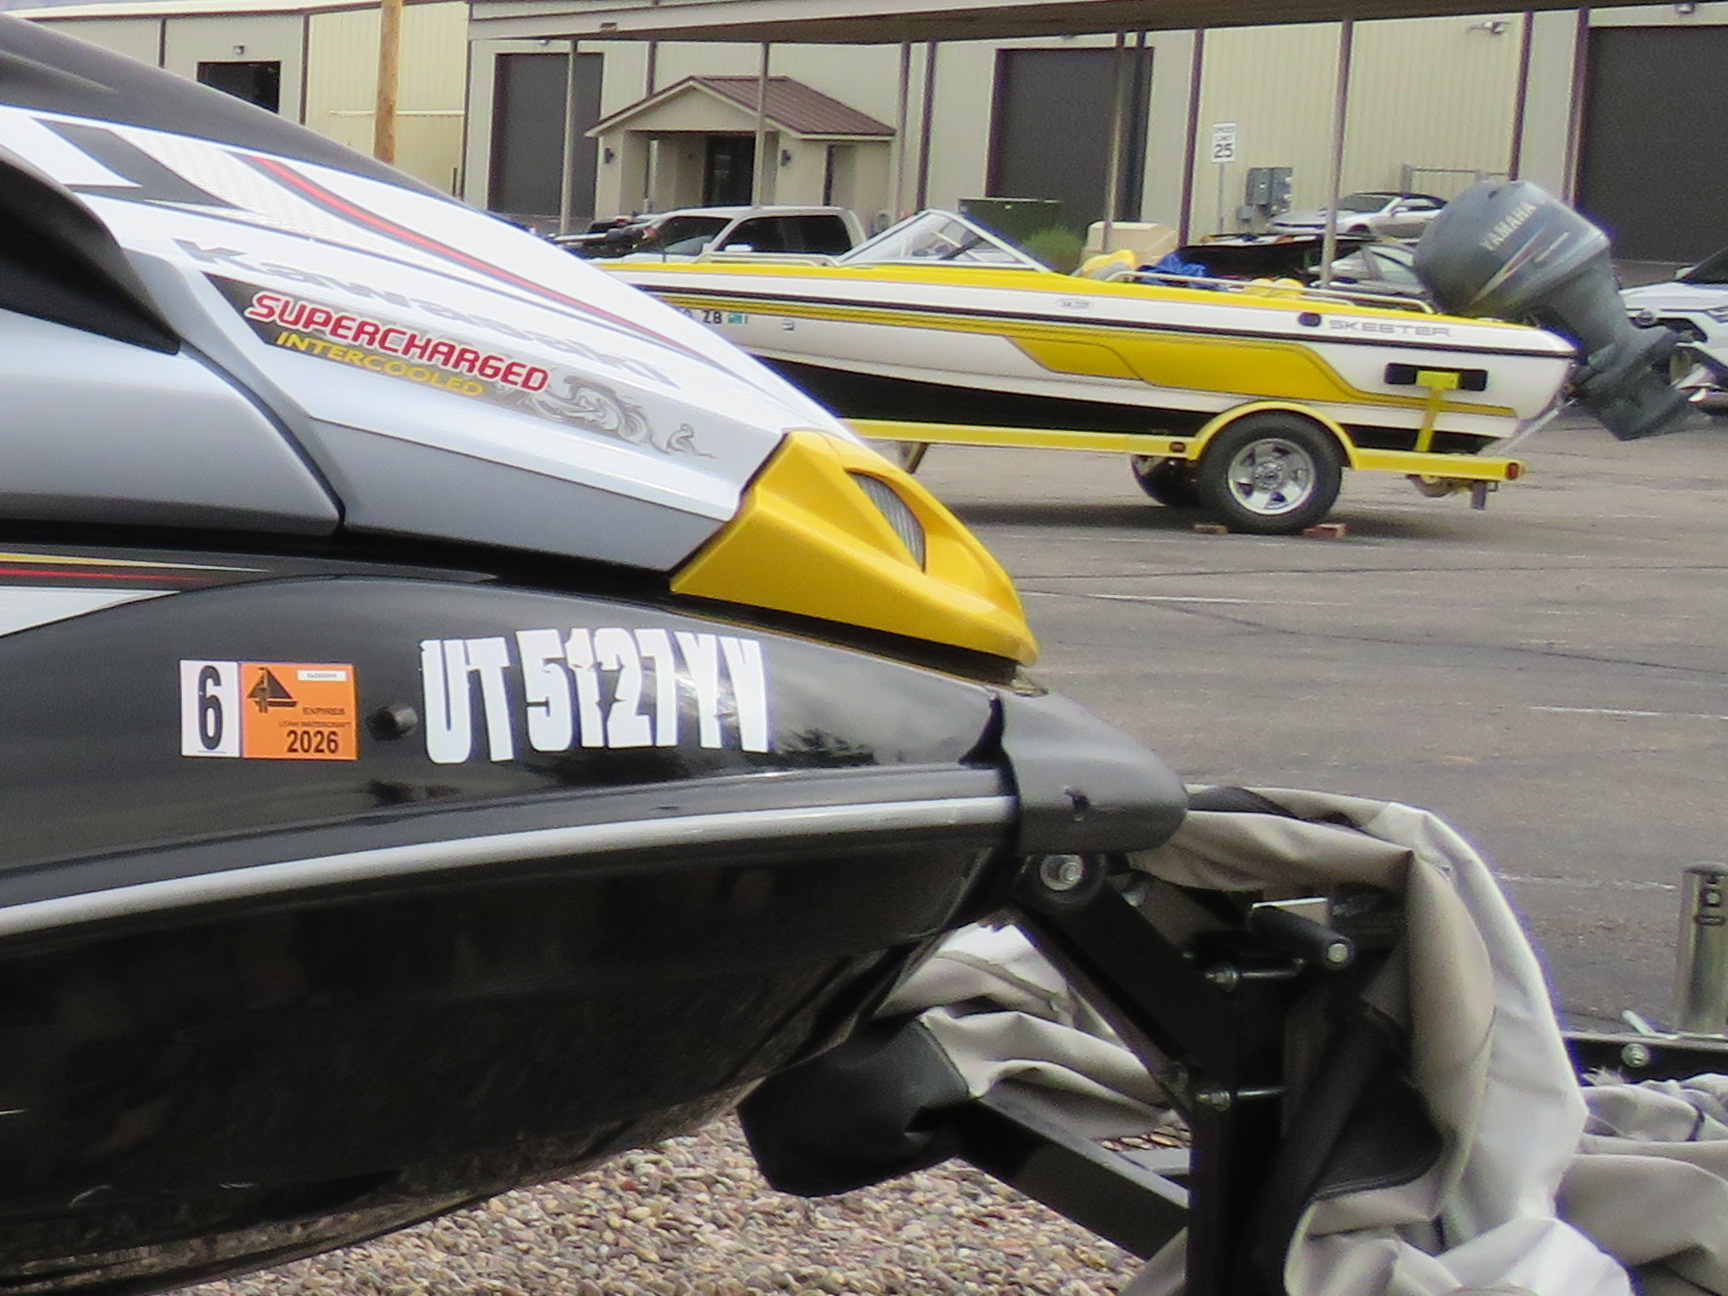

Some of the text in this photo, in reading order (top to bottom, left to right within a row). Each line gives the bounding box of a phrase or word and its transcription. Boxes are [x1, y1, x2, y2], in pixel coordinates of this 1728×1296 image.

[1214, 143, 1234, 159] 25
[1478, 201, 1537, 252] YAMAHA
[170, 237, 682, 391] Kawasaki
[245, 290, 552, 394] SUPERCHARGED
[1329, 320, 1451, 337] SKEETER
[275, 331, 485, 397] INTERCOOLED
[198, 665, 223, 750] 6
[420, 636, 514, 764] UT
[286, 730, 339, 754] 2026
